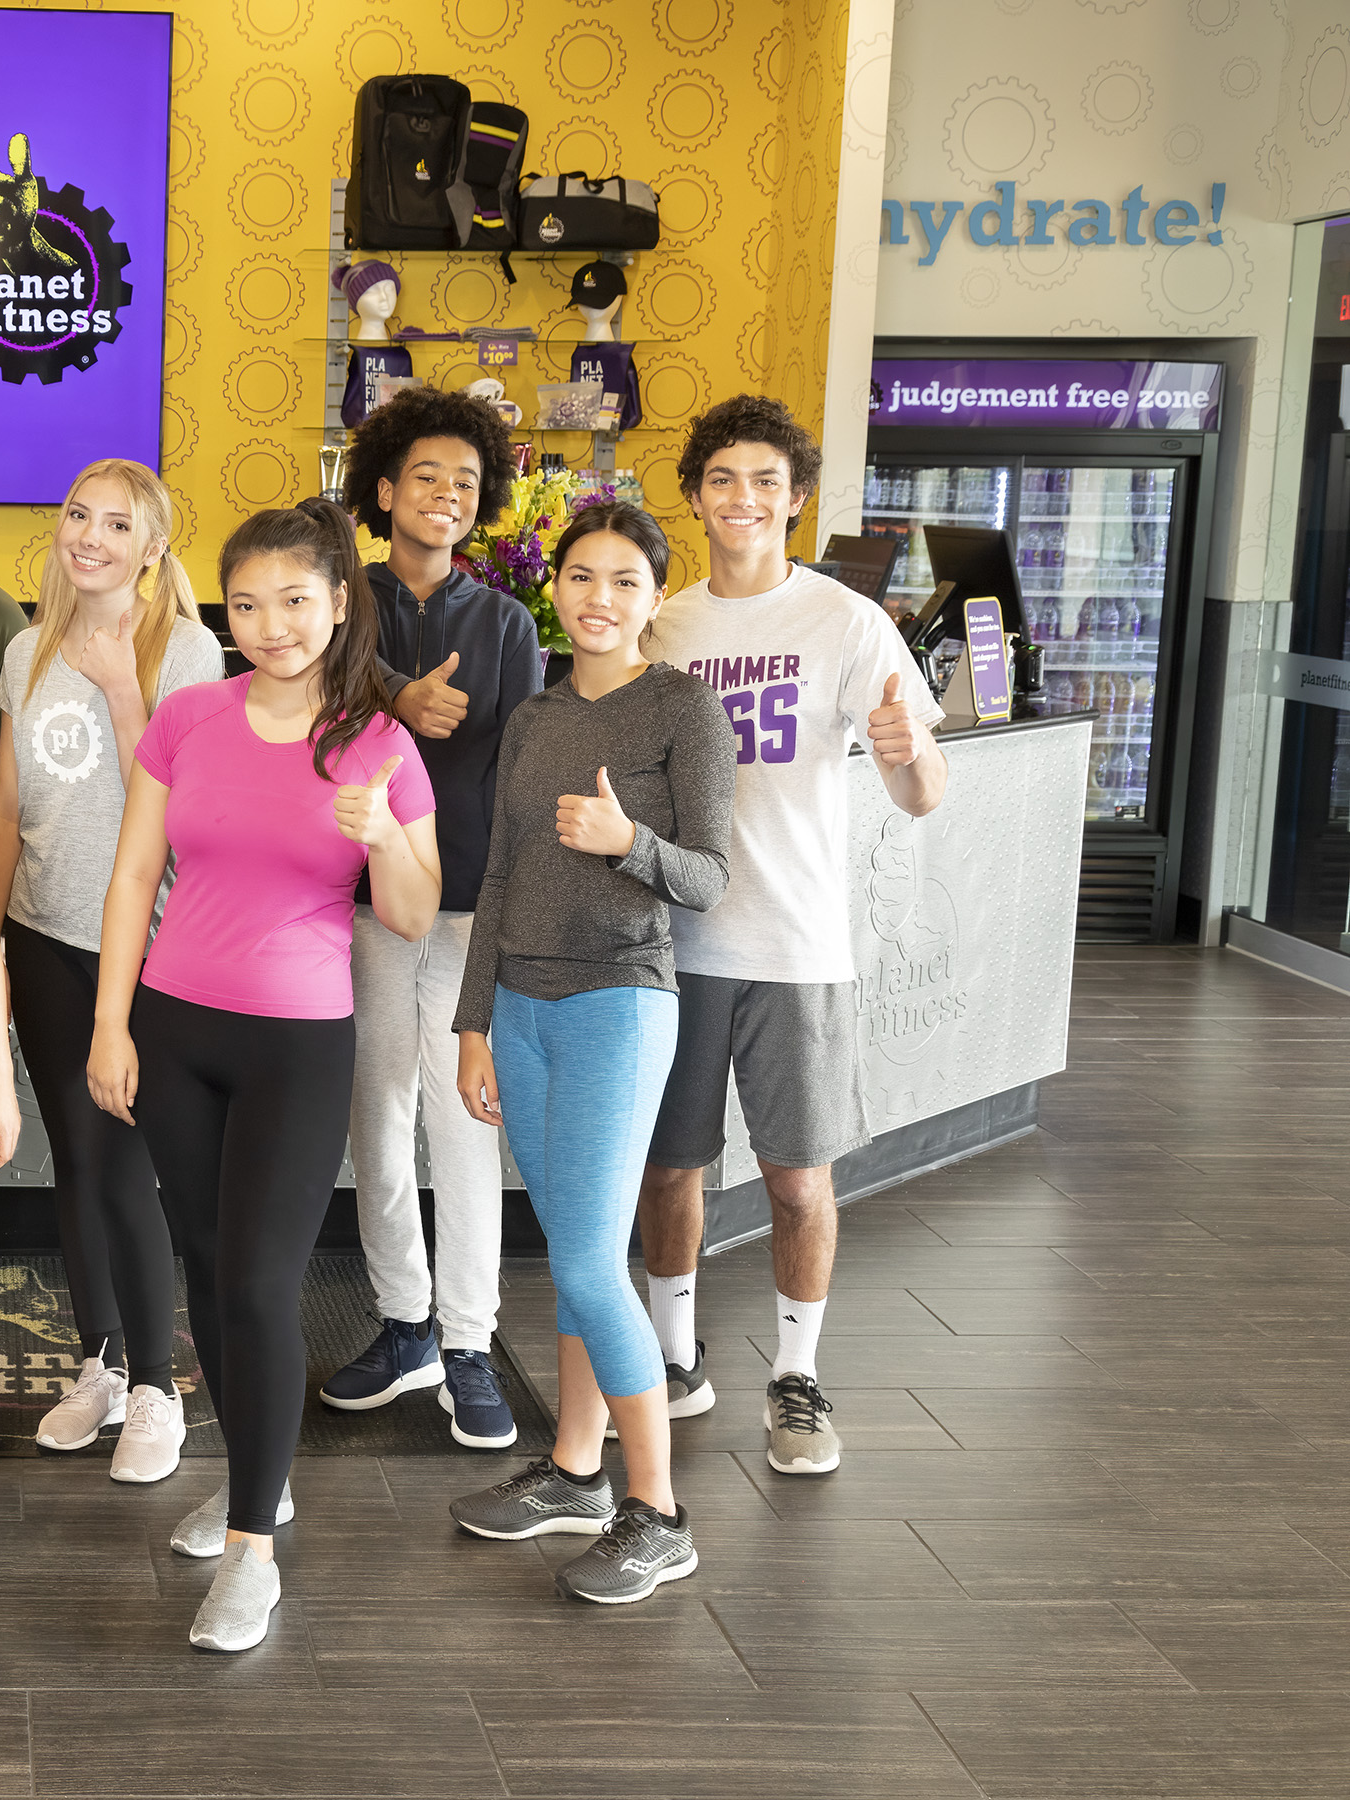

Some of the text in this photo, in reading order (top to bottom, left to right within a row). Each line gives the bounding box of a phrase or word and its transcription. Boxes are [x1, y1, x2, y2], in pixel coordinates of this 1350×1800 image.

[366, 357, 385, 372] PLA
[580, 360, 603, 374] PLA
[888, 380, 1059, 413] judgement
[1066, 382, 1130, 408] free
[1137, 389, 1210, 409] zone
[687, 654, 800, 692] SUMMER
[50, 723, 82, 755] pf
[721, 682, 799, 765] SS
[856, 937, 954, 1016] planet
[869, 988, 968, 1047] fitness
